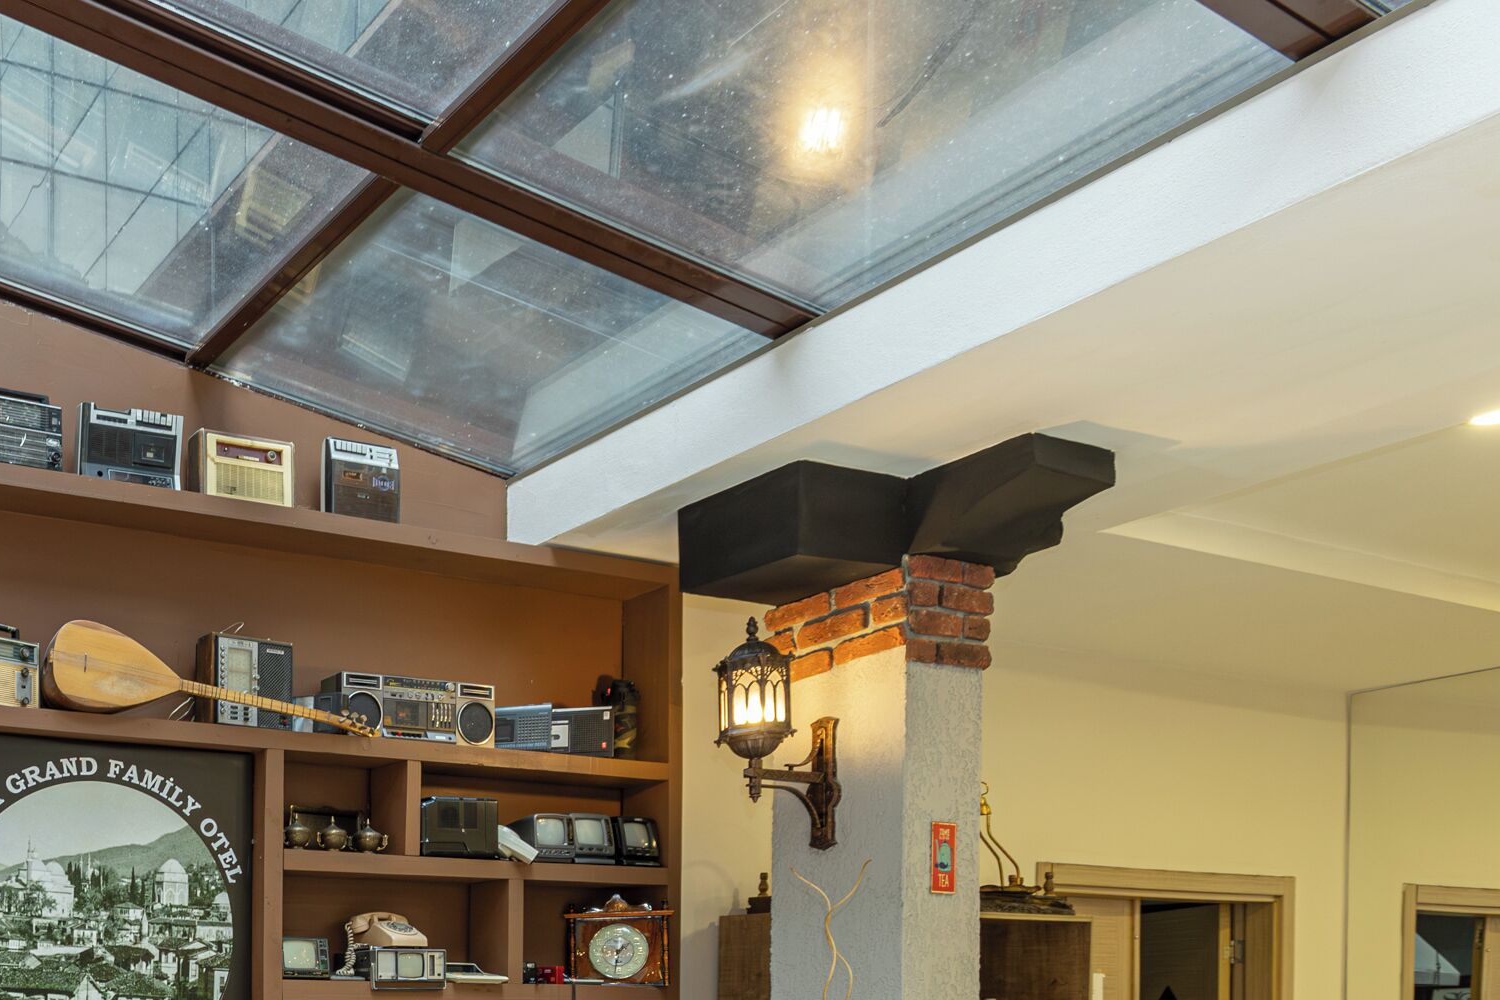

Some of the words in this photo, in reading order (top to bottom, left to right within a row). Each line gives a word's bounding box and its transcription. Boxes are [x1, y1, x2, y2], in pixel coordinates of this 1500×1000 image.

[5, 756, 99, 795] GRAND
[106, 758, 202, 817] FAMİLY
[199, 817, 243, 885] OTEL
[938, 873, 950, 887] TEA
